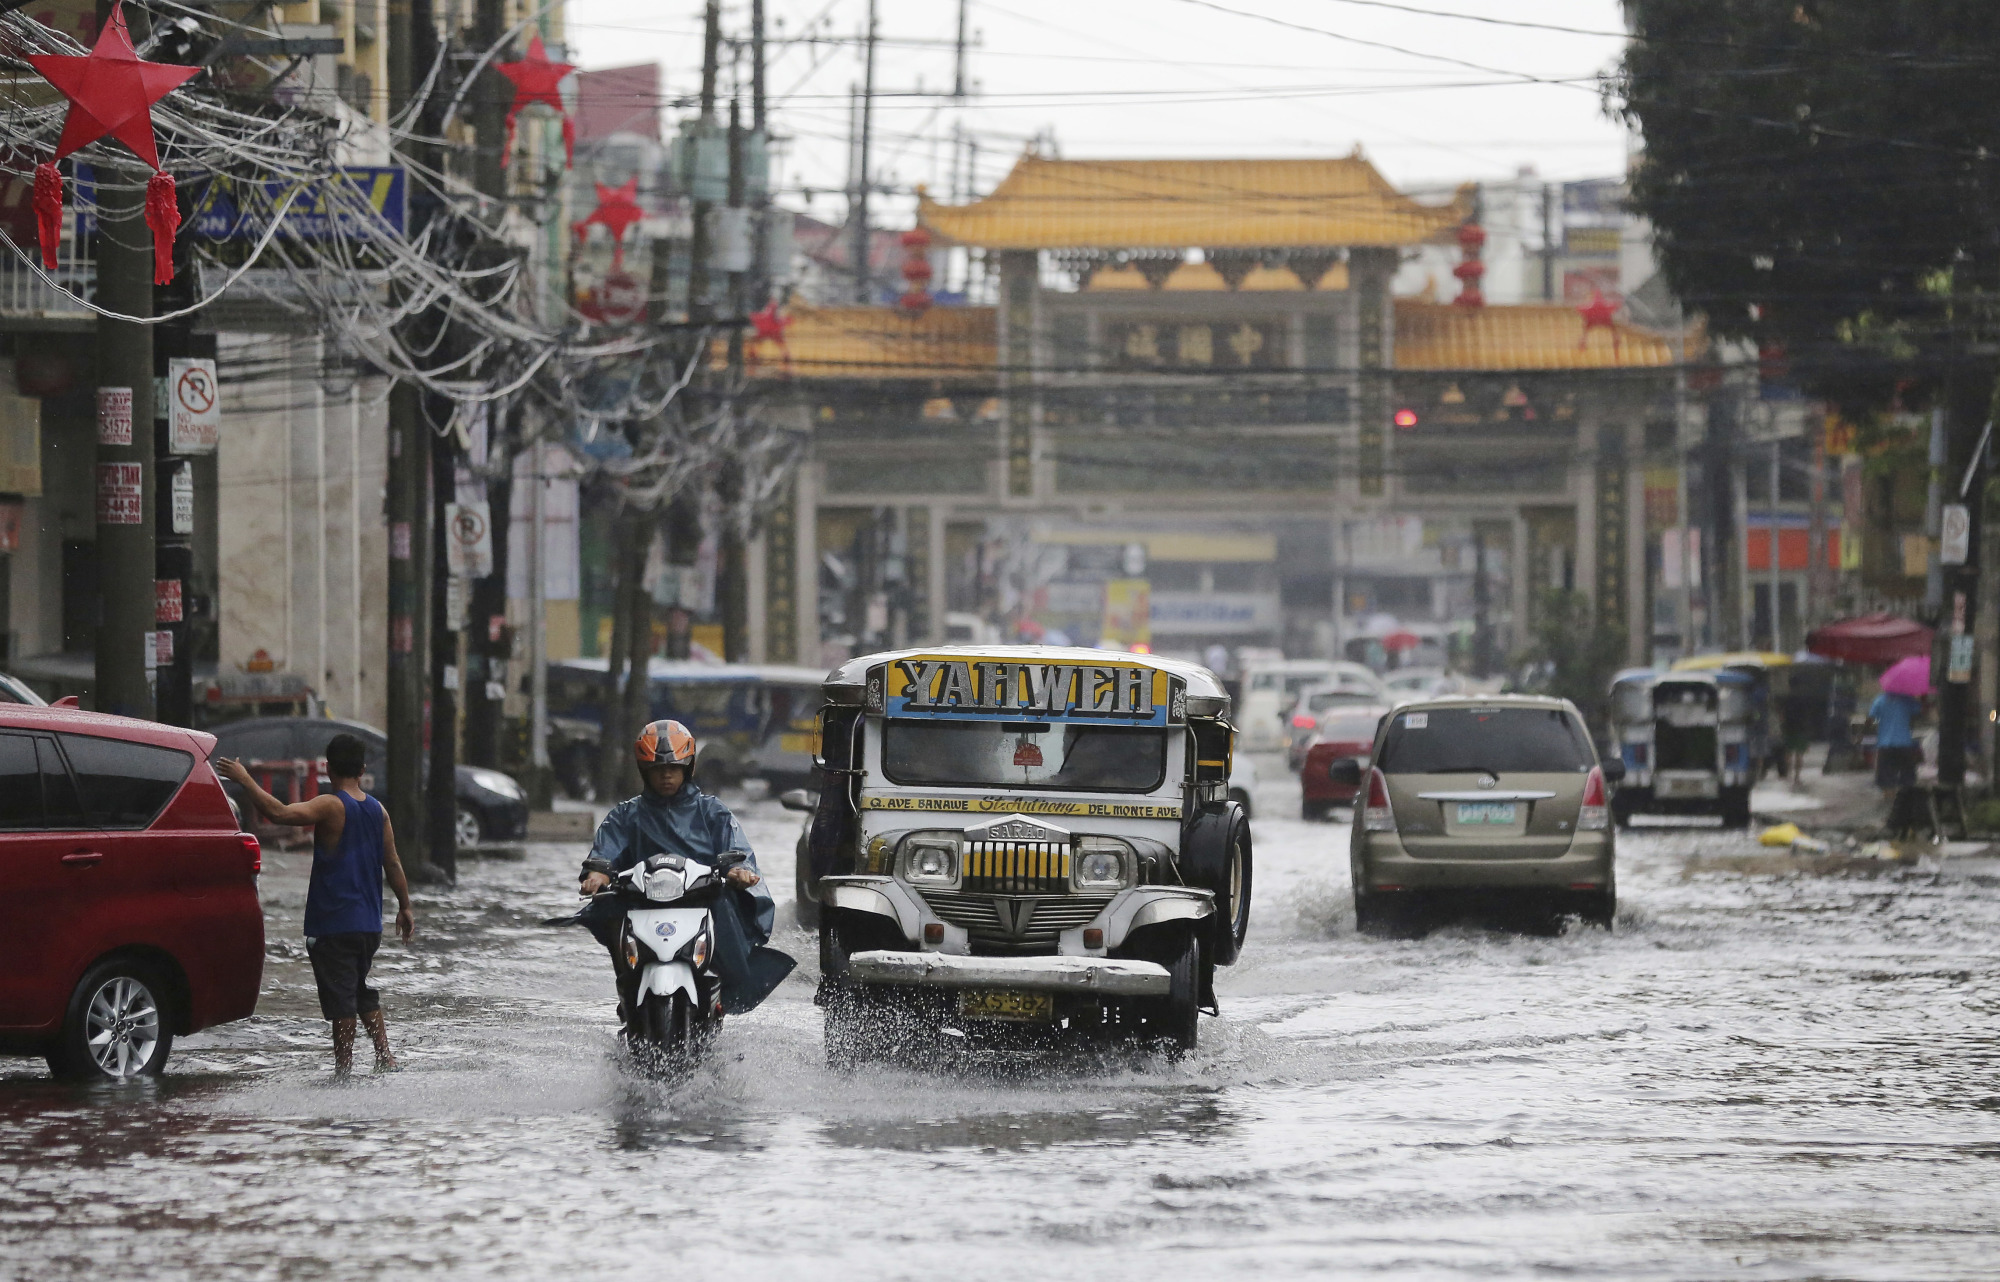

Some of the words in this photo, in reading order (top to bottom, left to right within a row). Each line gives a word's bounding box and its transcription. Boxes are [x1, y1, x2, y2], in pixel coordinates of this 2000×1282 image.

[177, 412, 191, 424] NO
[177, 424, 217, 435] PARKING
[897, 659, 1157, 717] YAHWEH
[888, 798, 914, 809] AVE.
[918, 799, 969, 810] BANAWE
[1088, 804, 1111, 815] DEL
[1113, 805, 1153, 816] MONTE
[1156, 806, 1180, 818] AVE.
[989, 823, 1045, 840] SARAO
